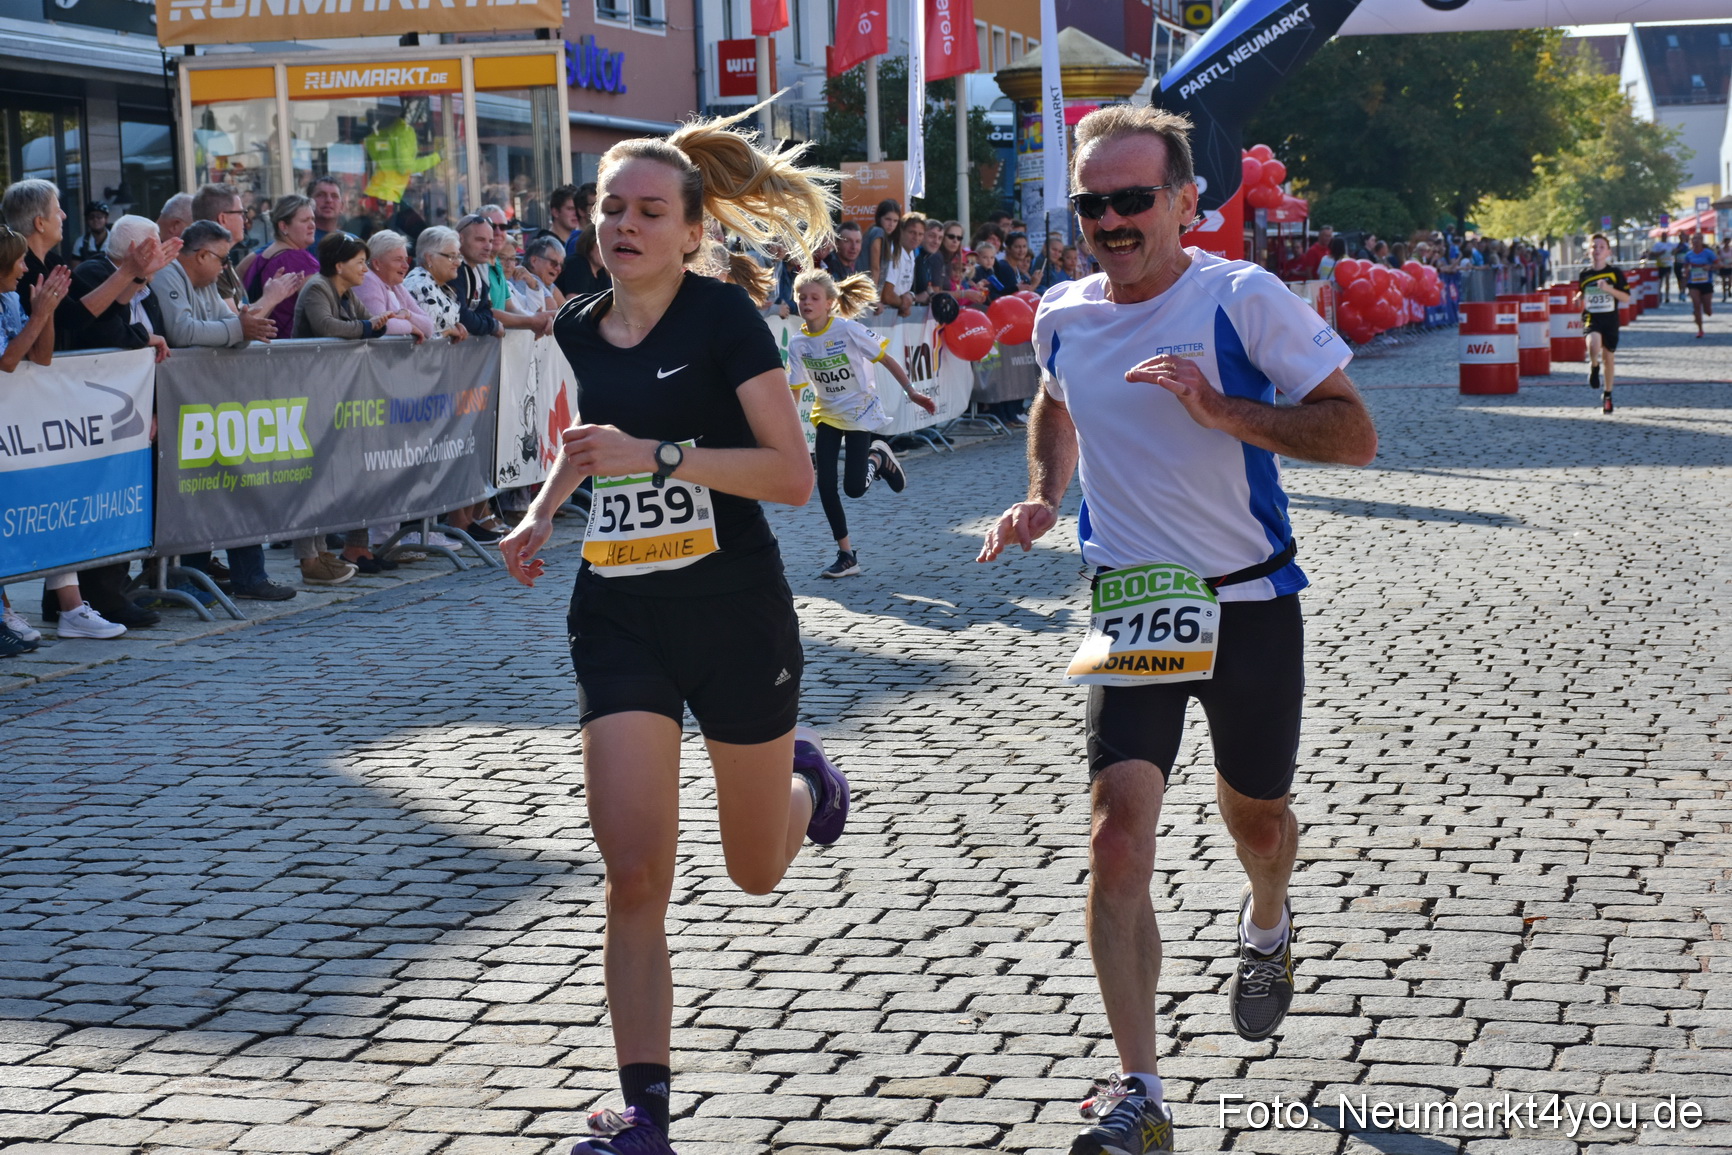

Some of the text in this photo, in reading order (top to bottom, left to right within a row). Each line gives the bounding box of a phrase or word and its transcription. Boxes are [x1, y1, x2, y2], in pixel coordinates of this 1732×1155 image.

[1179, 3, 1311, 100] PARTL NEUMARKT
[304, 67, 448, 90] RUNMARKT.DE
[1588, 295, 1611, 304] 4035
[1173, 343, 1204, 353] PETTER
[1466, 341, 1495, 354] AVIA
[814, 368, 850, 384] 4040
[334, 398, 385, 430] OFFICE
[180, 404, 310, 462] BOCK
[178, 465, 313, 496] inspired by smart concepts
[3, 485, 143, 537] STRECKE ZUHAUSE
[599, 486, 694, 533] 5259
[1101, 570, 1204, 604] BOCK
[1103, 606, 1201, 647] 5166
[1092, 656, 1185, 672] JOHANN
